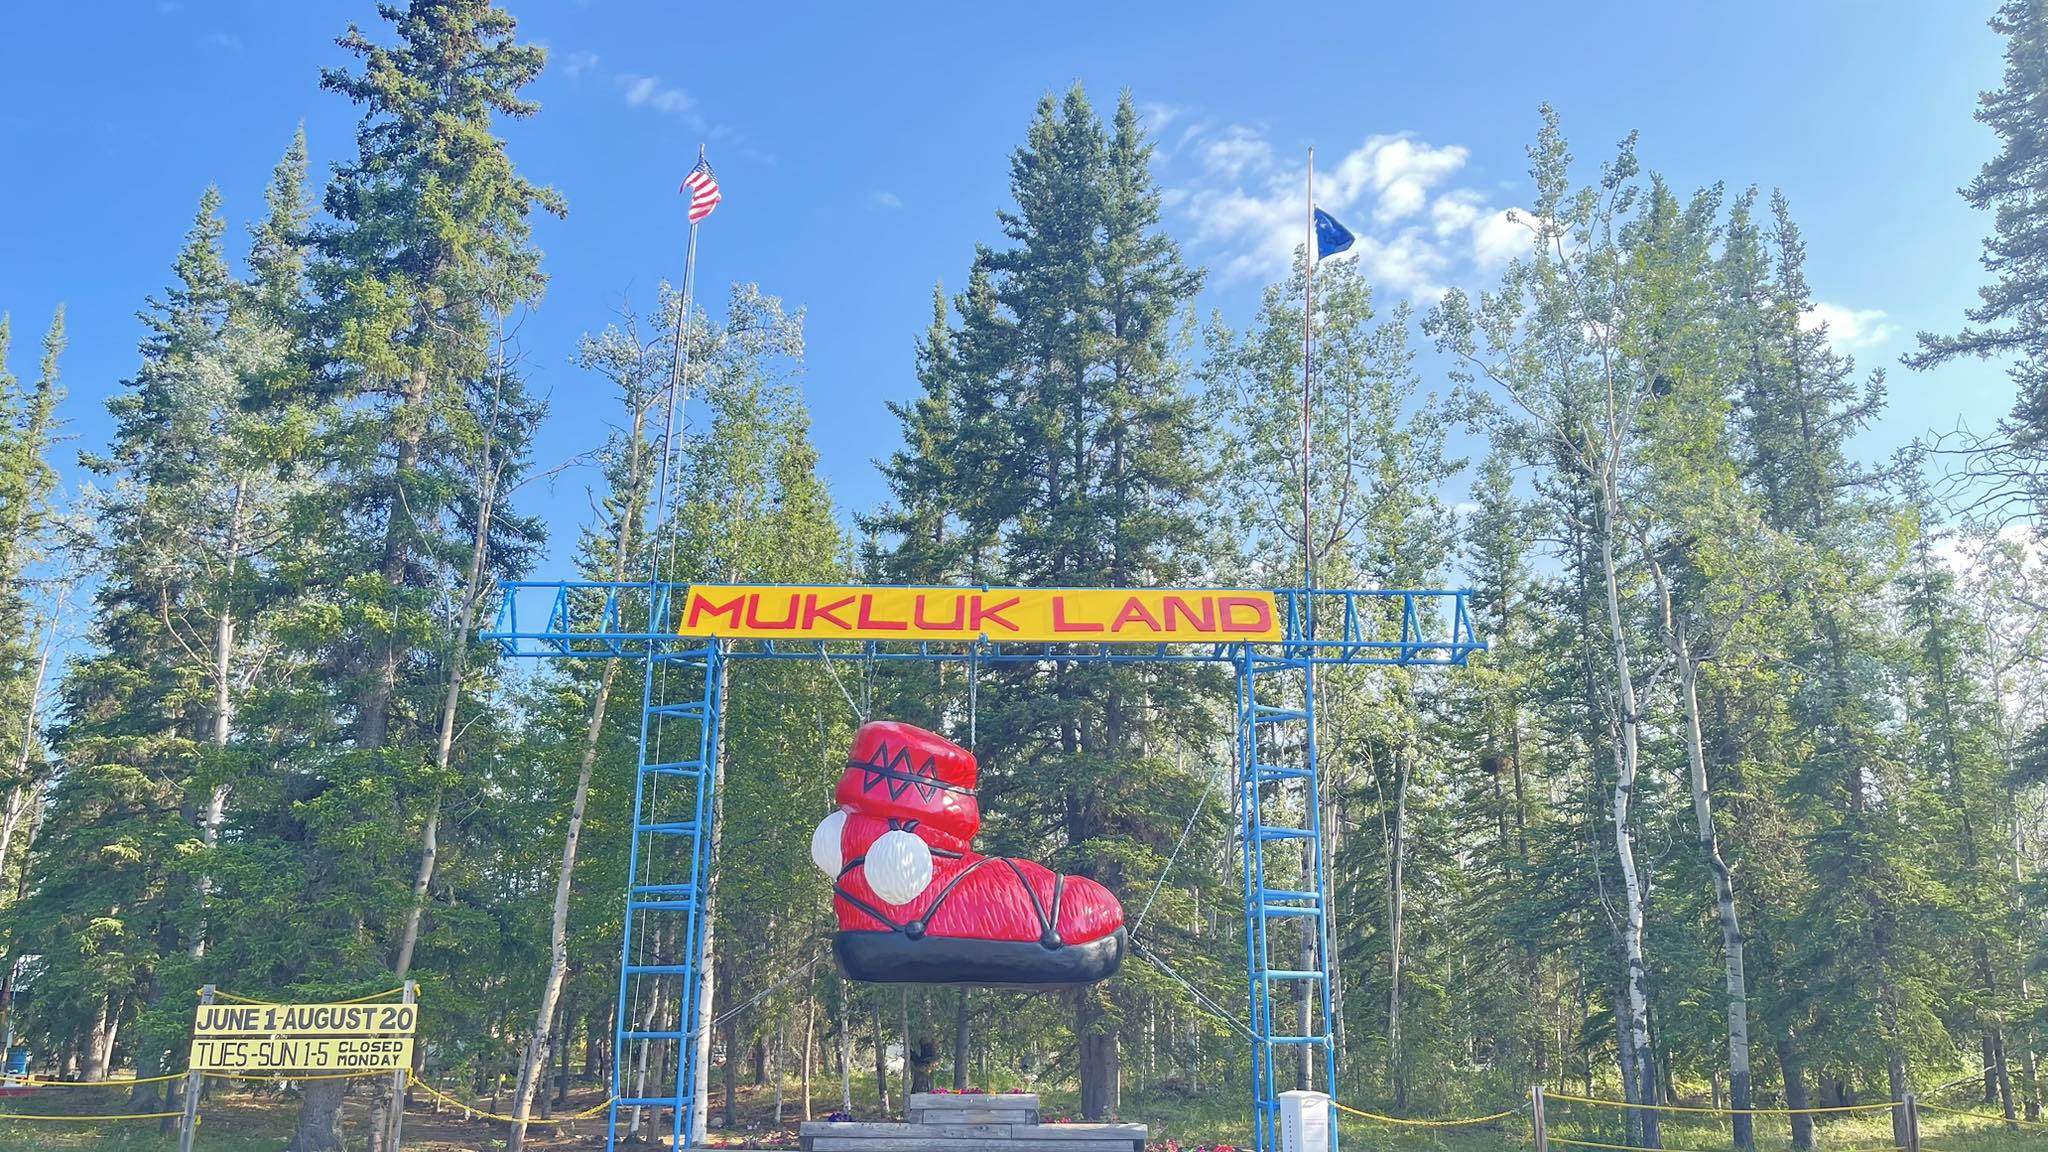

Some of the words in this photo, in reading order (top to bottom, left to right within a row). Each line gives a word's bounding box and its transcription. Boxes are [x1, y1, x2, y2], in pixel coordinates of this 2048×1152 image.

[687, 592, 1021, 632] MUKLUK
[1052, 596, 1272, 632] LAND
[197, 1008, 260, 1031] JUNE
[379, 1007, 414, 1031] 20
[304, 1041, 330, 1066] 1-5
[338, 1041, 404, 1053] CLOSED
[336, 1054, 401, 1067] MONDAY
